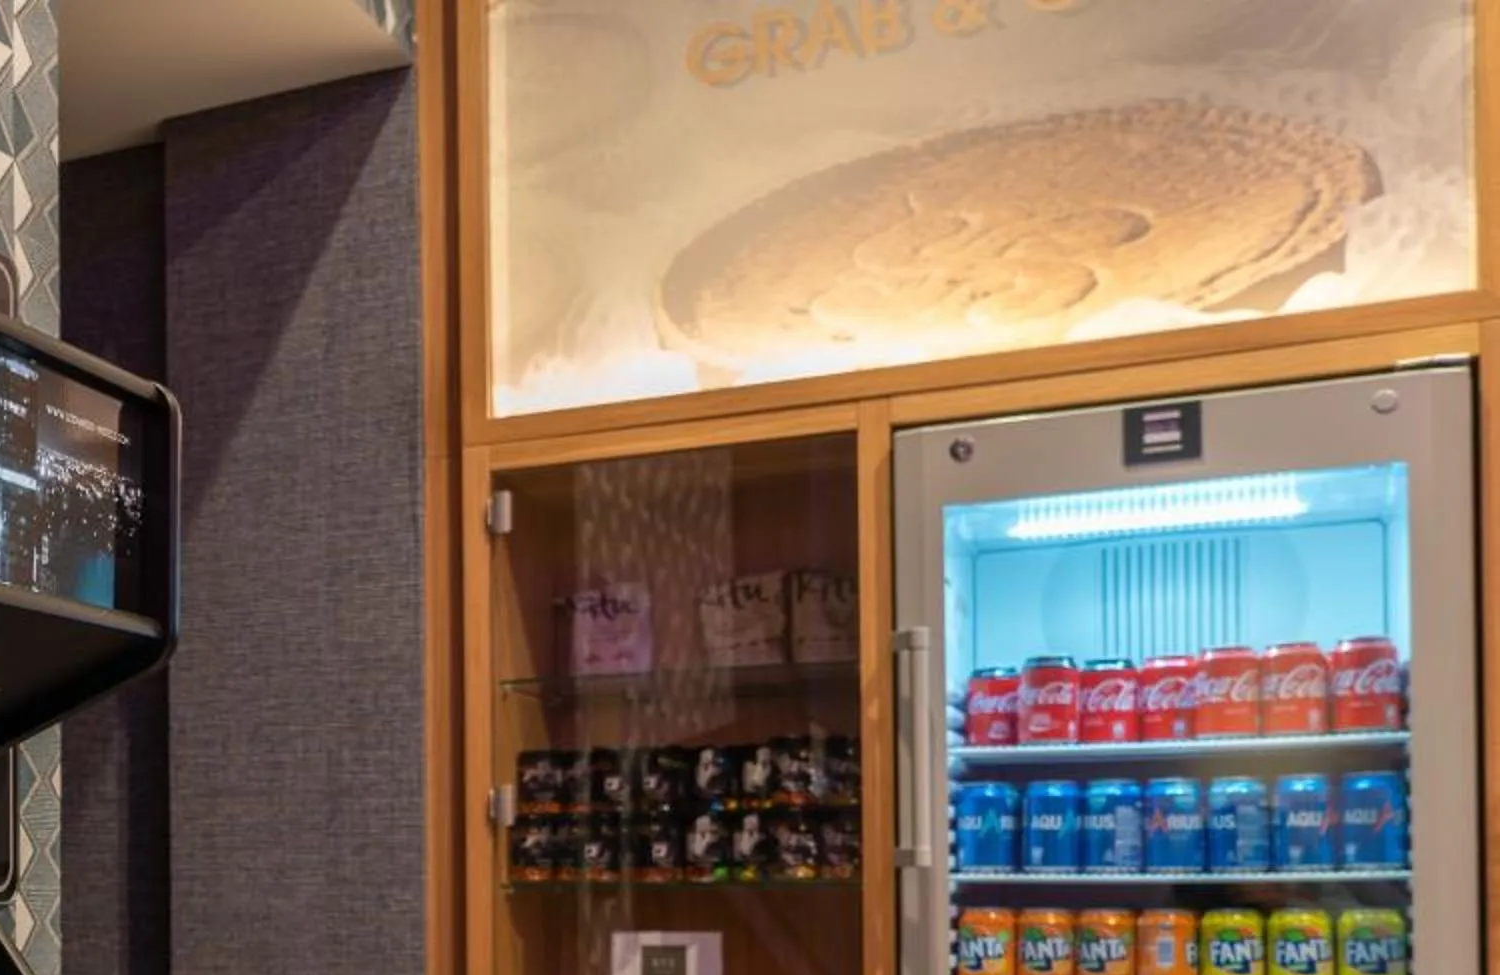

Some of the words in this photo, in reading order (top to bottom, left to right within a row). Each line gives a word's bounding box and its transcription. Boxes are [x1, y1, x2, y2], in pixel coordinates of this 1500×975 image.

[685, 0, 907, 85] GRAB
[1210, 938, 1263, 964] FANT
[1276, 938, 1333, 964] FANT
[1346, 938, 1404, 966] FANT
